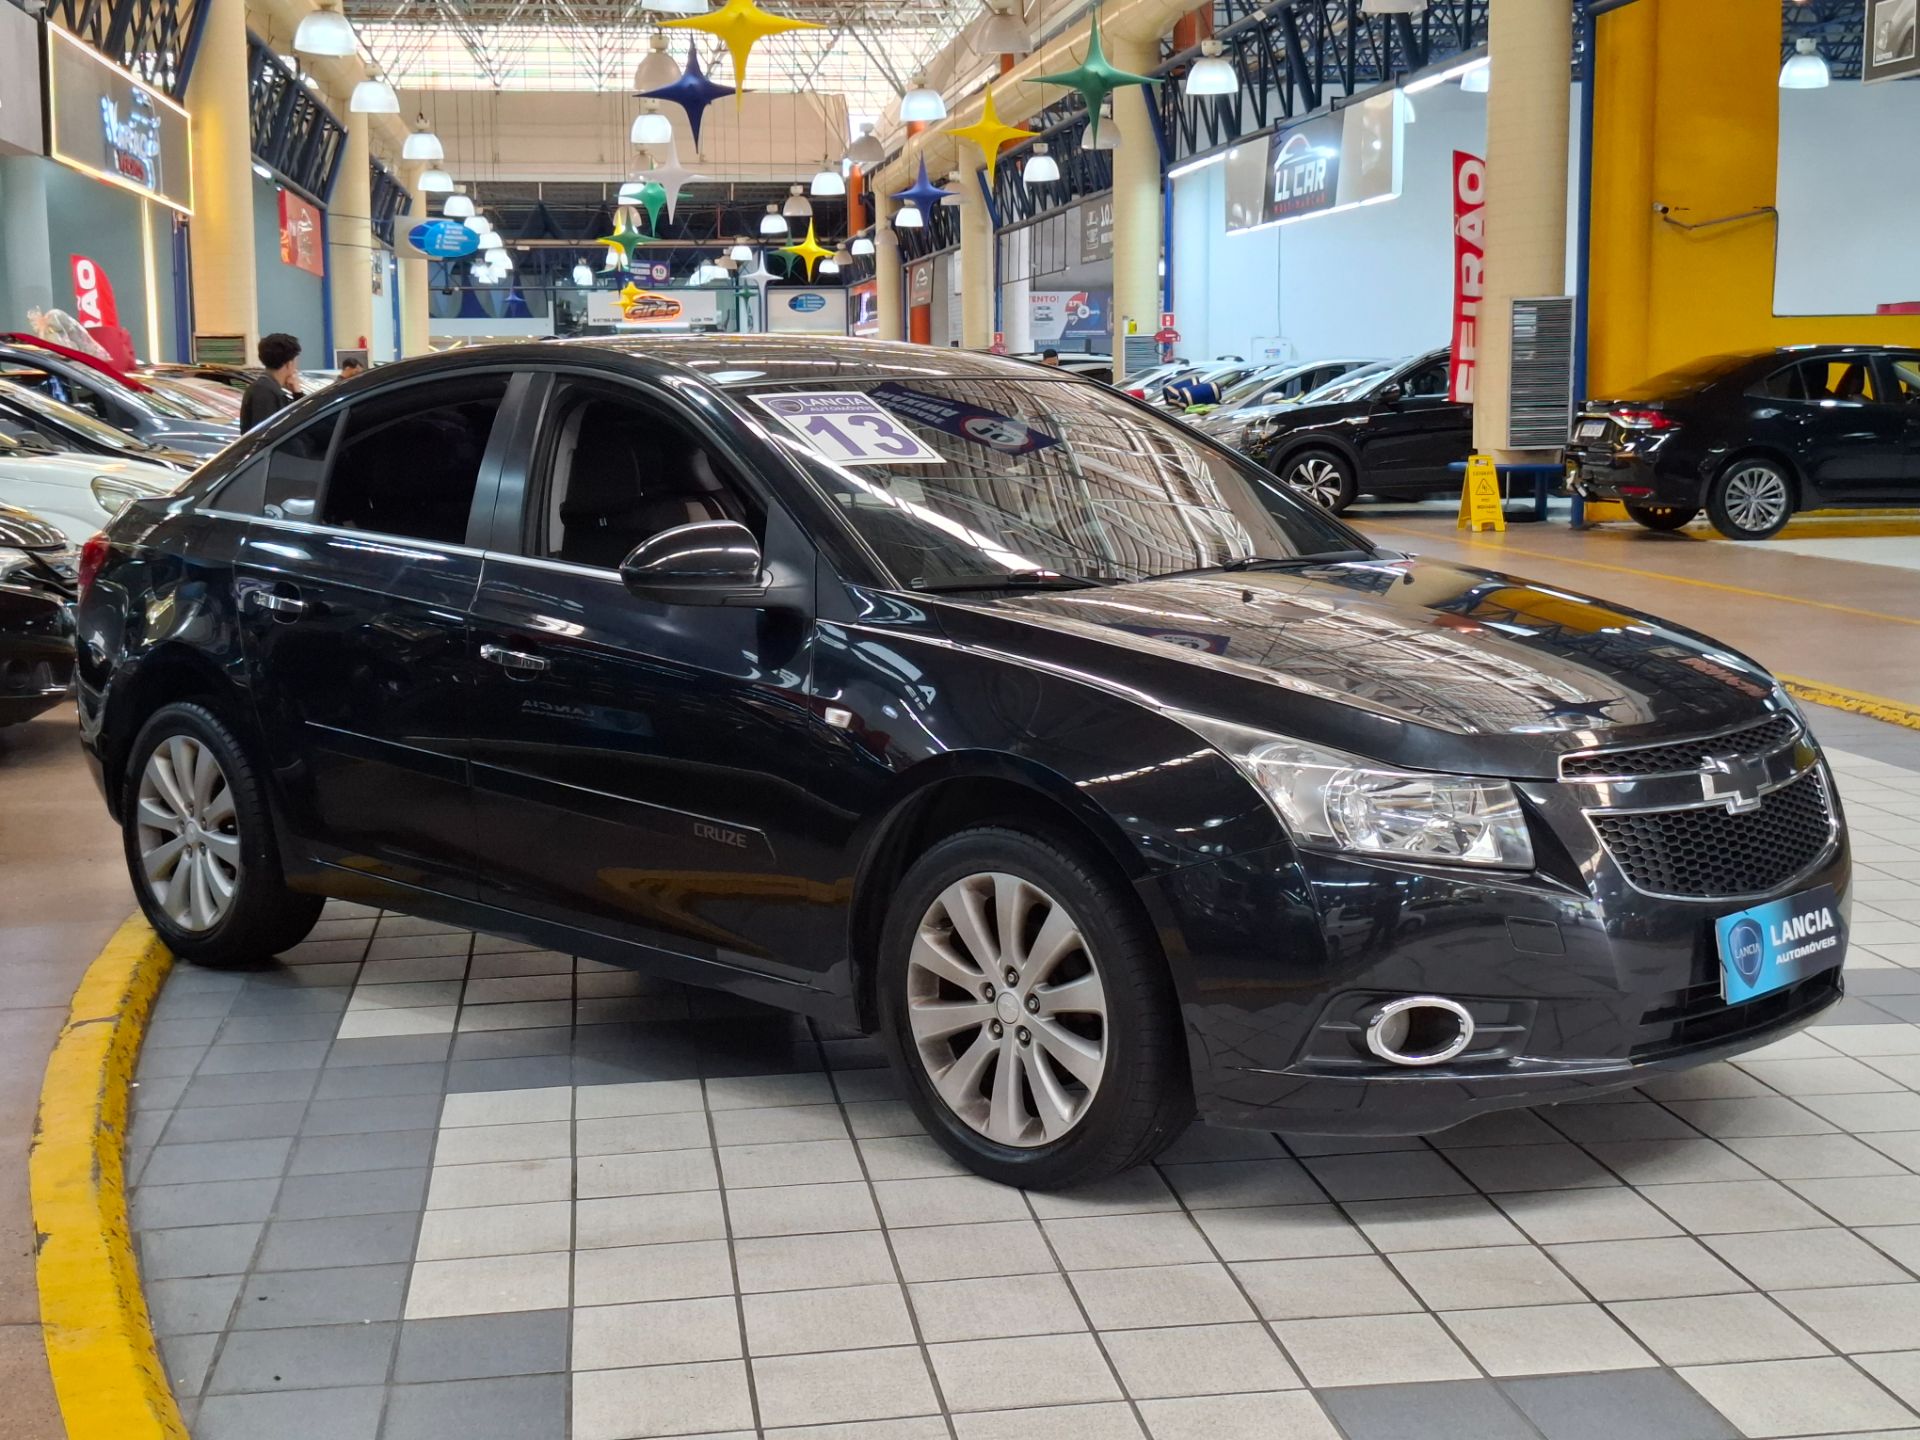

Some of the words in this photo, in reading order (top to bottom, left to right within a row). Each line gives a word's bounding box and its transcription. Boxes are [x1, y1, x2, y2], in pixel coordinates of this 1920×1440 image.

[1274, 169, 1290, 202] LL
[1293, 157, 1327, 197] CAR
[76, 259, 103, 328] ÃO
[1029, 295, 1060, 305] ENTO!
[798, 397, 870, 407] LANCIA
[804, 415, 920, 457] 13
[693, 822, 748, 849] CRUZE
[1770, 906, 1834, 947] LANCIA
[1734, 942, 1761, 960] LANCIA
[1775, 935, 1838, 966] AUTOMÓVEIS
